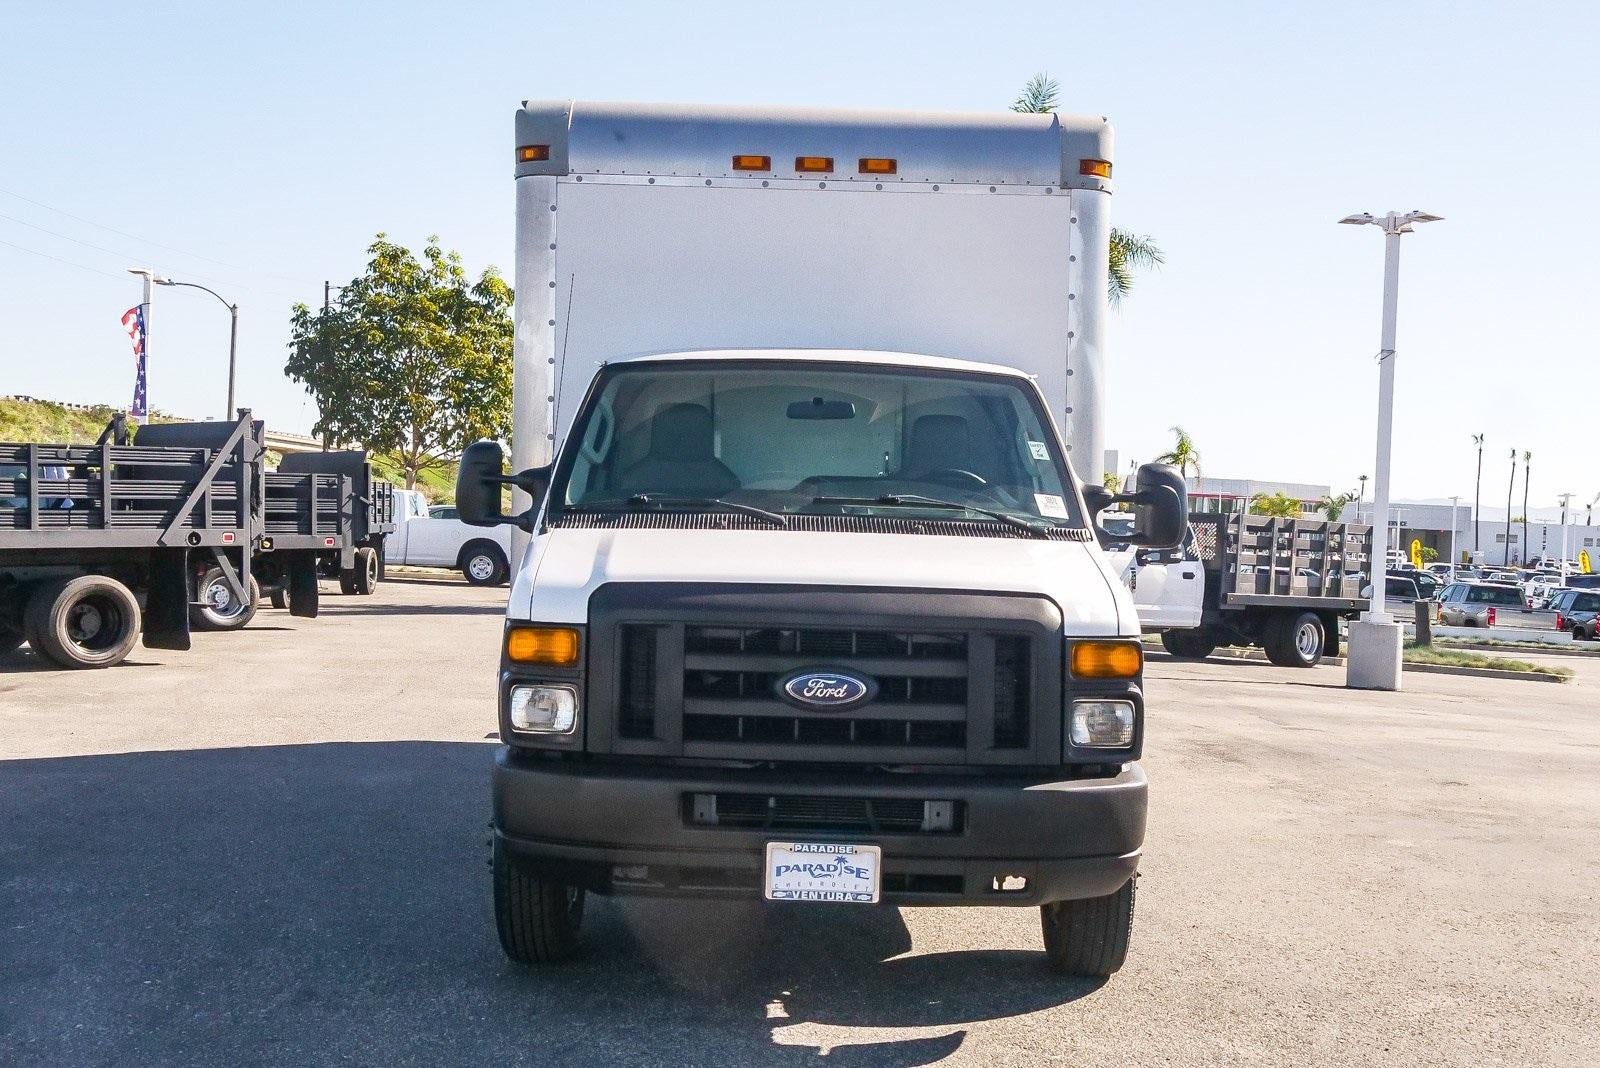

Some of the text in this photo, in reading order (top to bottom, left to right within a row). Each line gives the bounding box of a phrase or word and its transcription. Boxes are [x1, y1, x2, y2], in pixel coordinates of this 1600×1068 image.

[803, 678, 848, 698] Ford
[794, 844, 854, 854] PARADISE
[775, 856, 870, 880] PARADISE
[792, 891, 854, 901] VENTURA
